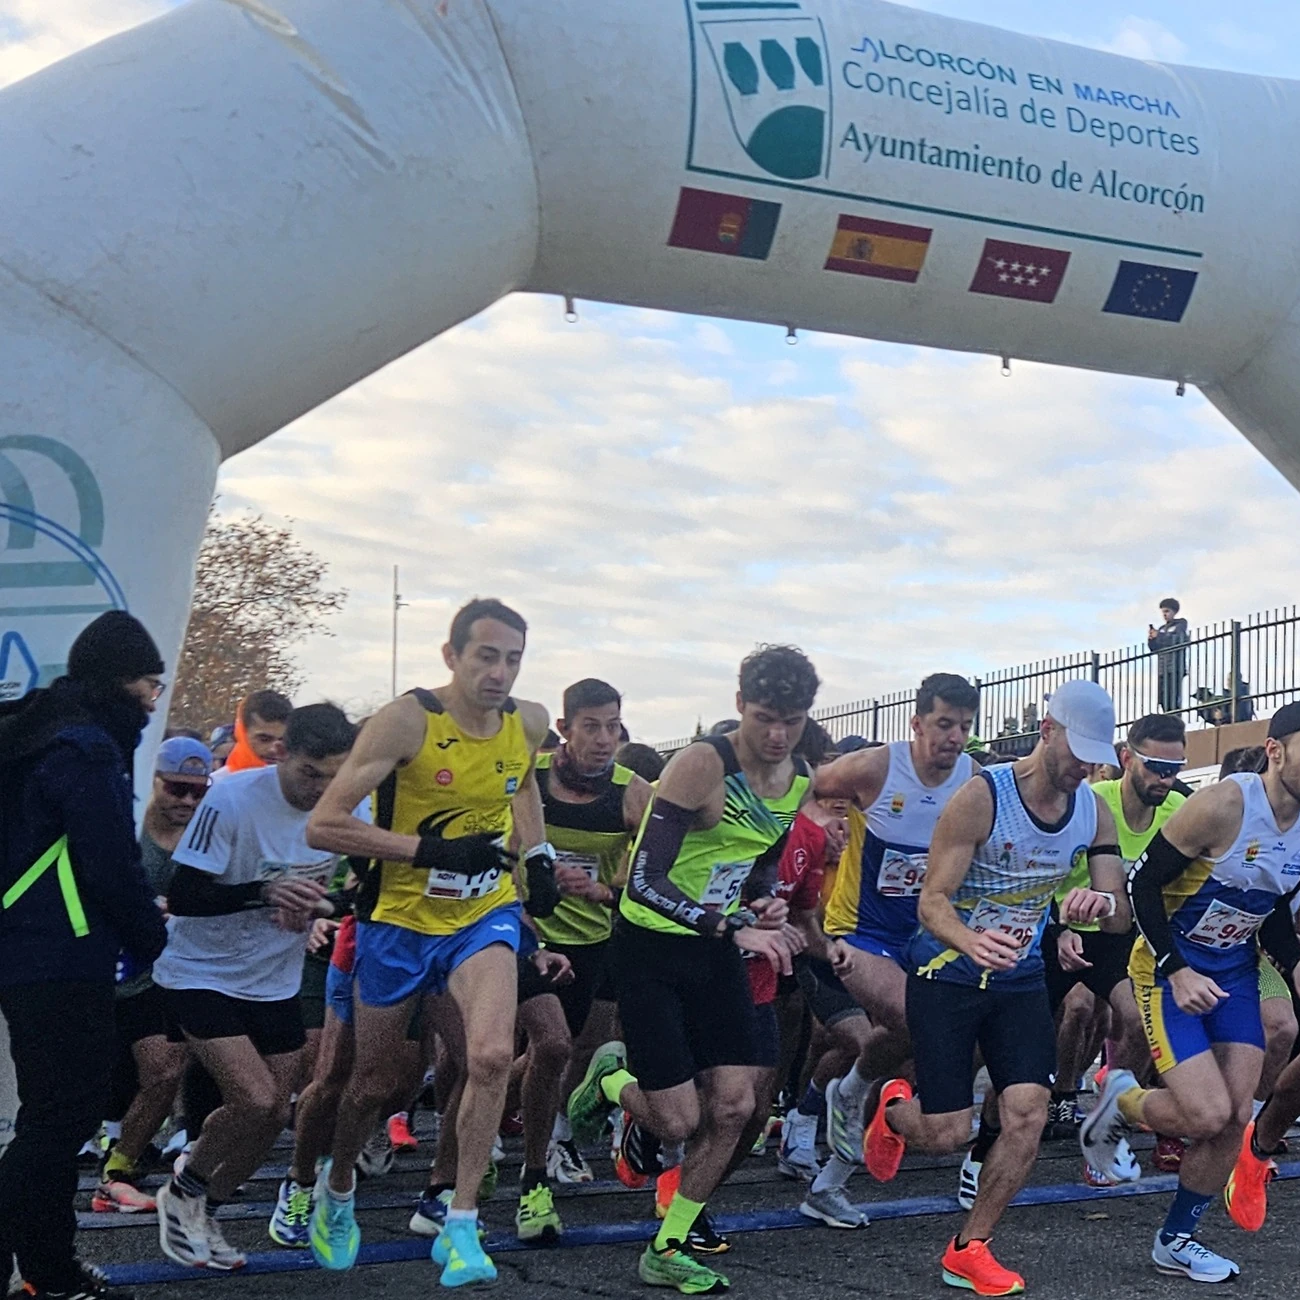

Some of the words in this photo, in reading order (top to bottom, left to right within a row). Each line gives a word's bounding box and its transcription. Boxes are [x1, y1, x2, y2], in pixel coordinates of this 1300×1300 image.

[842, 60, 1008, 119] Concejalía
[1020, 98, 1056, 128] de
[1066, 106, 1200, 156] Deportes
[1027, 72, 1064, 95] EN
[1072, 82, 1181, 119] MARCHA
[839, 121, 1042, 185] Ayuntamiento
[1051, 160, 1083, 192] de
[1089, 168, 1205, 214] Alcorcón
